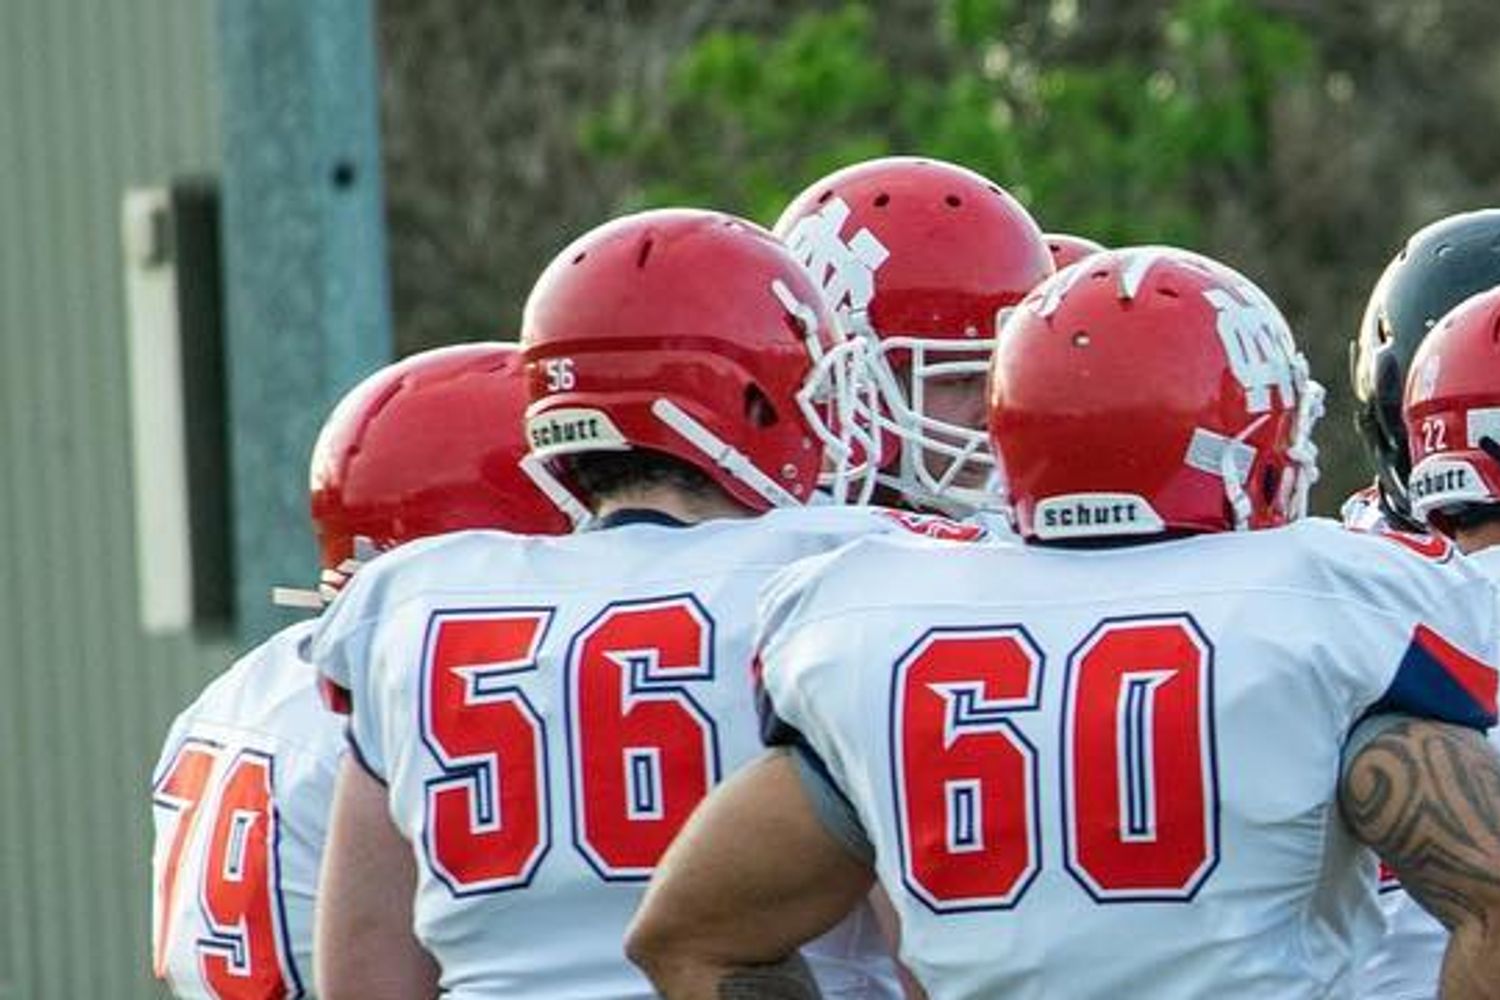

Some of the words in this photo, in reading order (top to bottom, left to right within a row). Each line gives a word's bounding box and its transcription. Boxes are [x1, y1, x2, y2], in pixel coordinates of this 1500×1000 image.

[546, 357, 576, 392] 56
[532, 418, 598, 447] schutt
[1422, 417, 1447, 452] 22
[1044, 503, 1137, 526] schutt
[419, 593, 723, 897] 56
[888, 612, 1221, 914] 60
[151, 737, 306, 1000] 79
